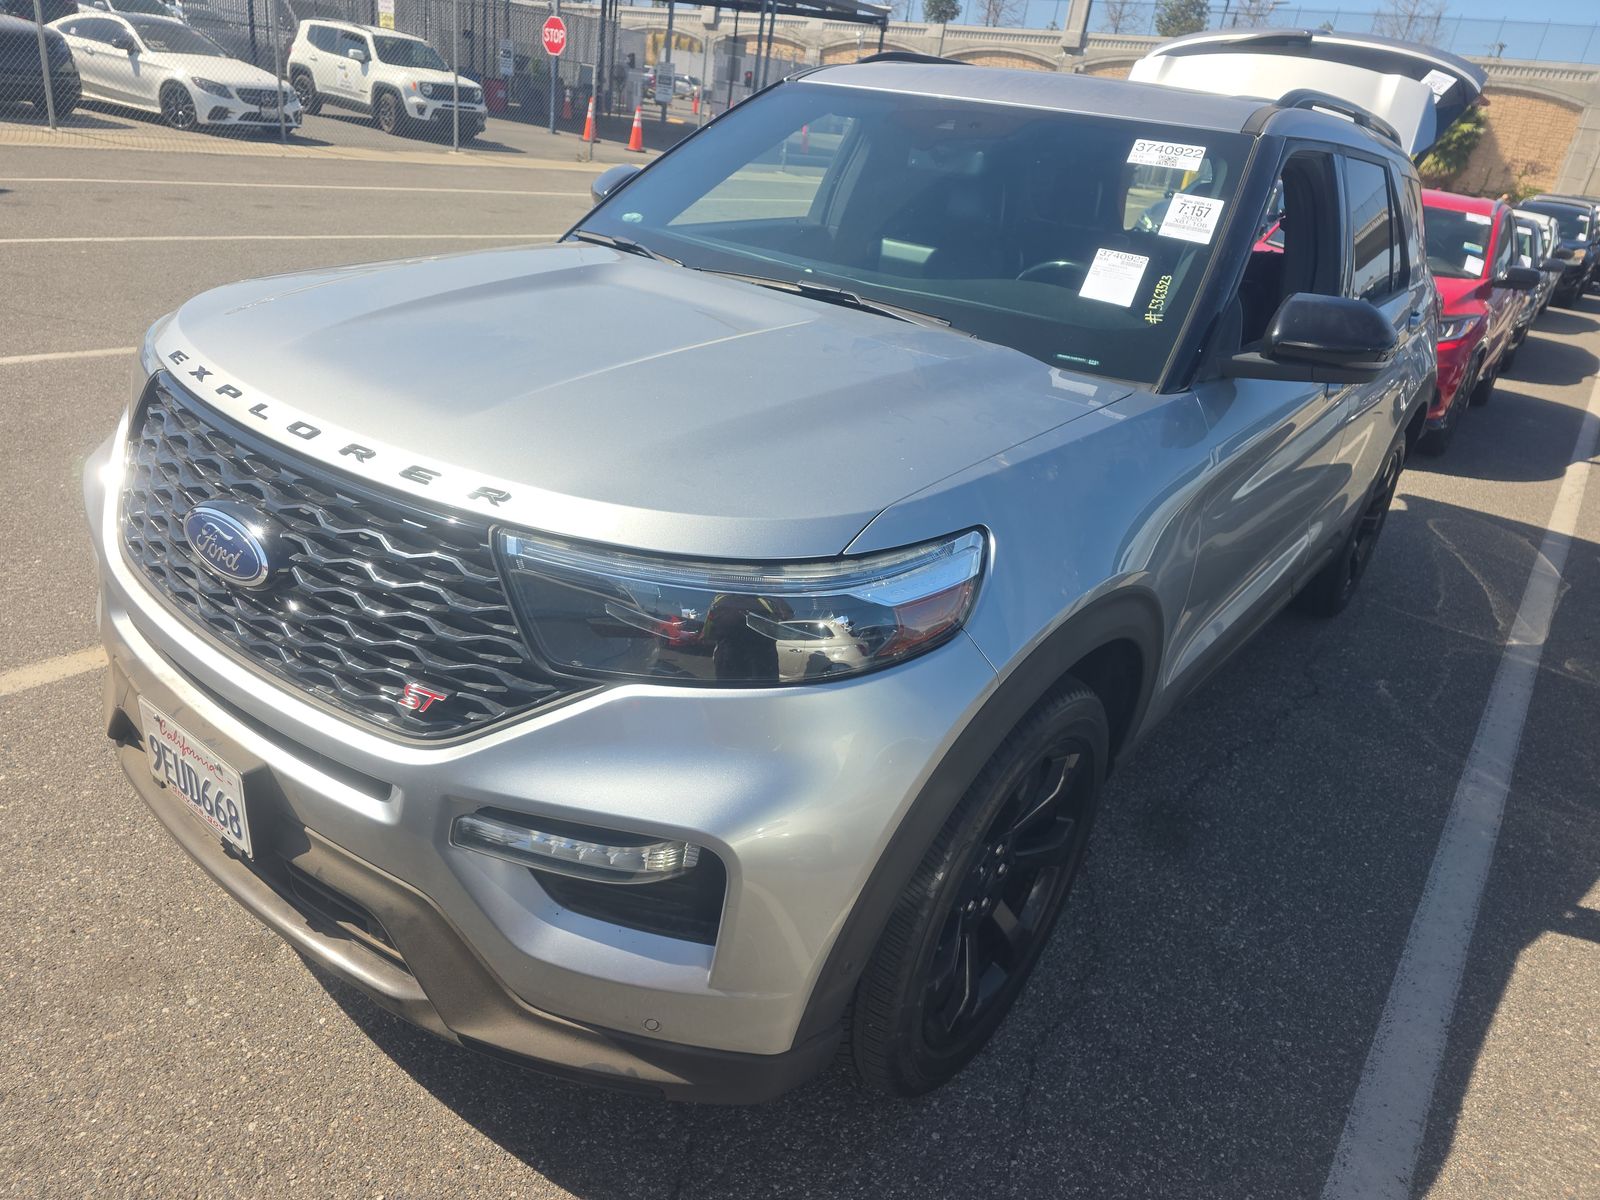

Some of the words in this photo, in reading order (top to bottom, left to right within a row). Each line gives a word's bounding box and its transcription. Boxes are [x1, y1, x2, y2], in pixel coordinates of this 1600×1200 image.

[544, 27, 565, 43] STOP
[1136, 143, 1204, 158] 3740922
[1178, 202, 1212, 218] 7:157
[1100, 250, 1148, 264] 3740922
[168, 350, 512, 507] EXPLORER
[197, 521, 243, 574] Ford
[398, 683, 448, 712] ST
[158, 719, 222, 781] California
[149, 734, 242, 840] 9EUD668
[171, 785, 225, 831] dmv.ca.gov
